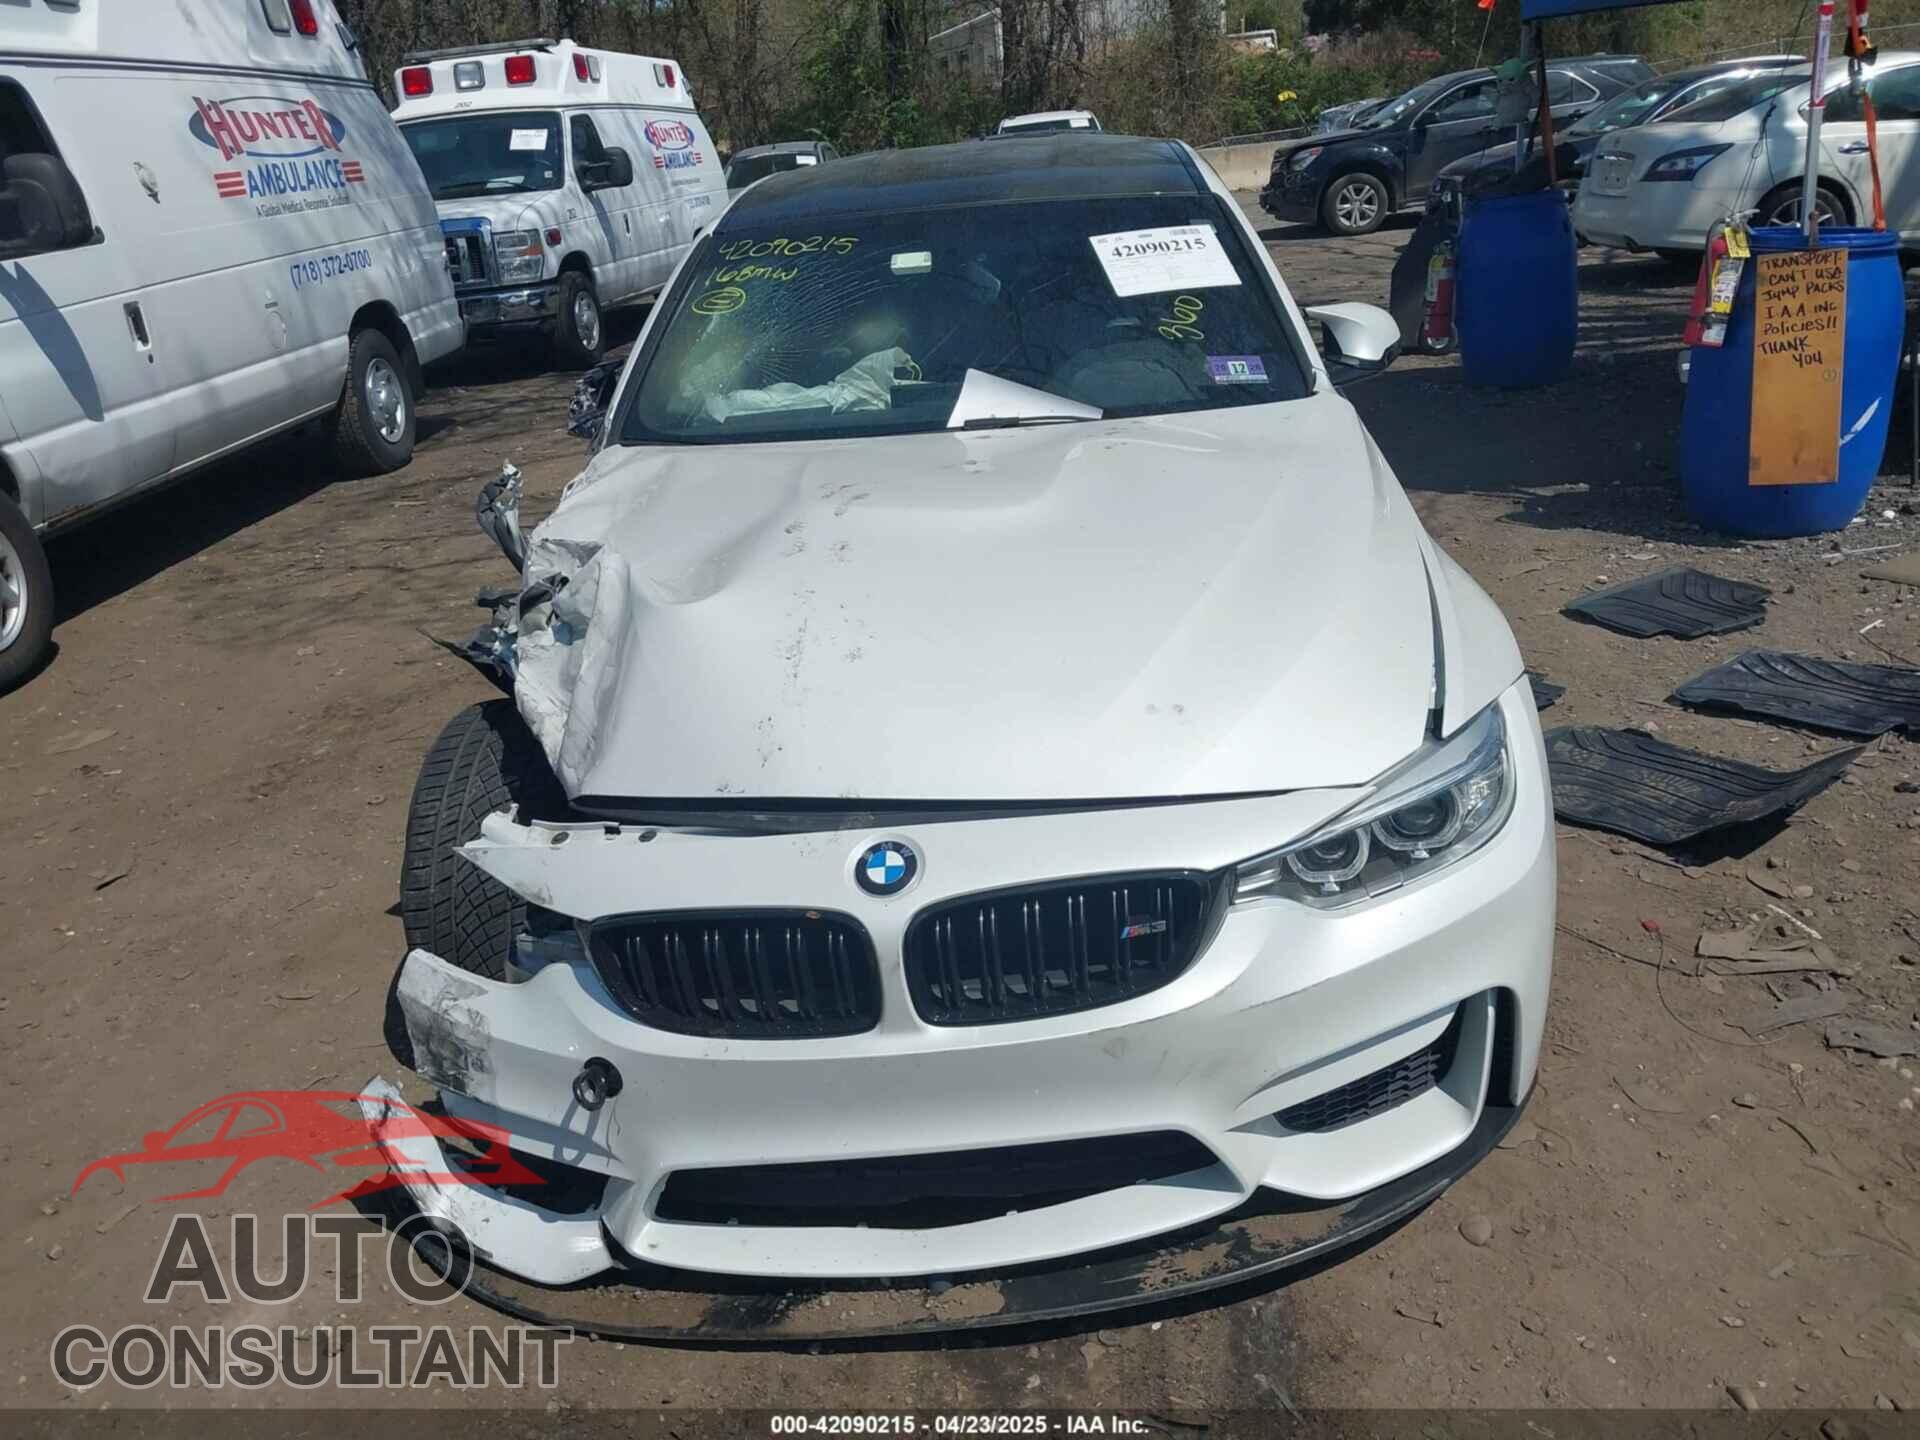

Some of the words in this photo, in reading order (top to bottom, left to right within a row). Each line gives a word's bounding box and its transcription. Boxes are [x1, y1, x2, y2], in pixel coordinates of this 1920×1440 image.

[192, 96, 342, 161] HUNTER
[247, 159, 346, 198] AMBULANCE
[719, 235, 860, 261] 42090215
[1112, 238, 1206, 258] 42090215
[290, 260, 323, 291] (718)
[321, 248, 372, 278] 372-0700
[1760, 250, 1840, 271] TRANSPORT
[1760, 335, 1809, 355] THANK
[1231, 363, 1248, 374] 12
[1792, 350, 1823, 368] YOU
